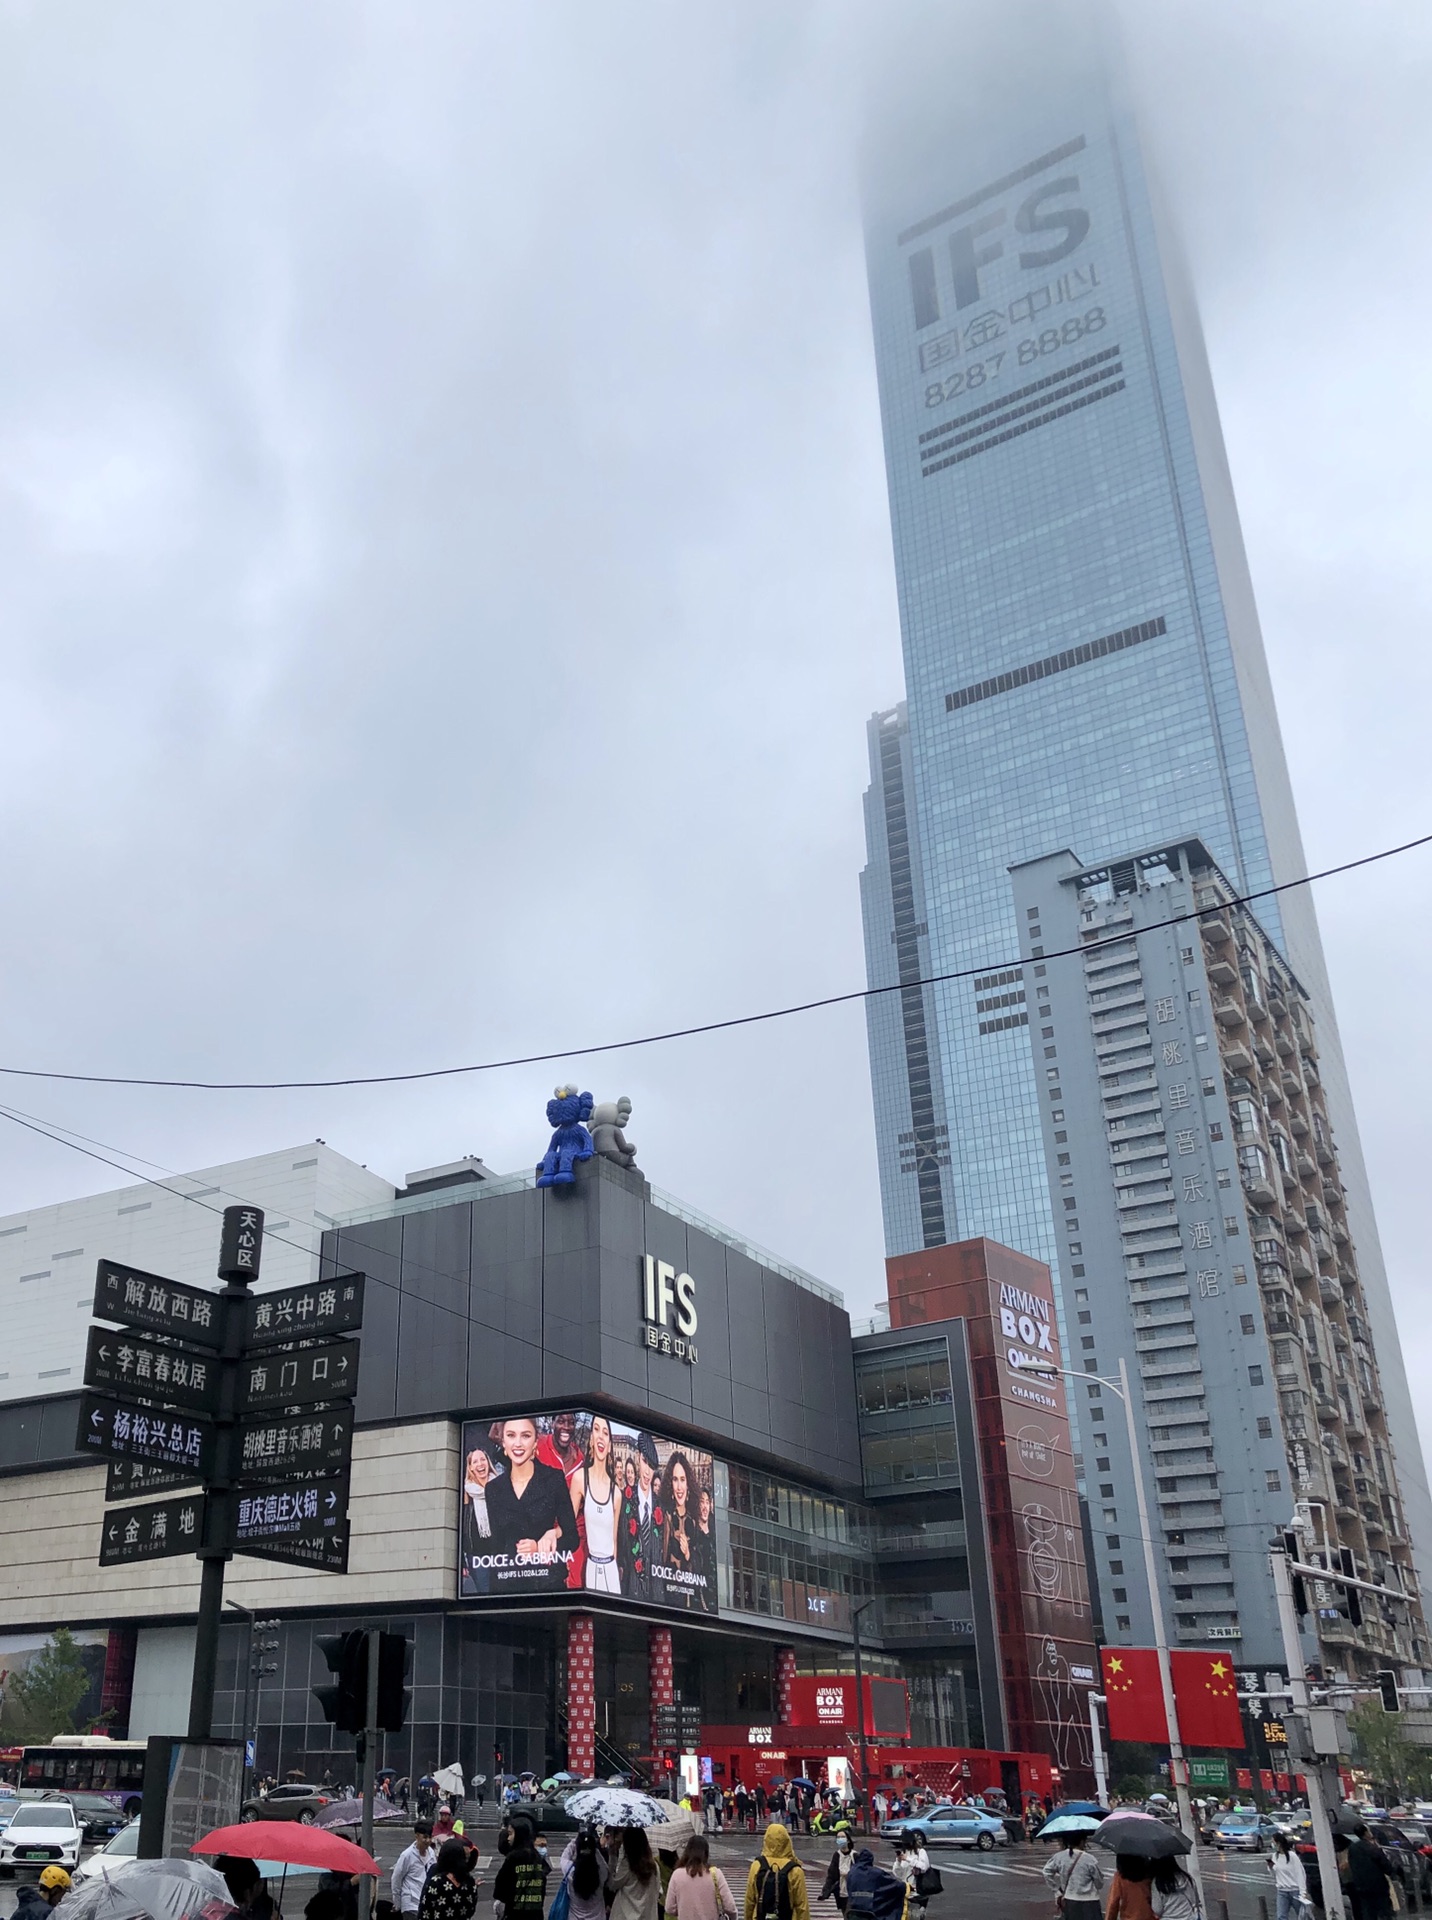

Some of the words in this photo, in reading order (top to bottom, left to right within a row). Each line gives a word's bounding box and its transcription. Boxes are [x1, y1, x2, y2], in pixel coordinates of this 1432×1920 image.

[908, 175, 1091, 331] IFS
[918, 263, 1101, 374] 国金中心
[924, 350, 1007, 408] 8287
[1017, 306, 1107, 366] 8888
[1154, 997, 1220, 1299] 胡桃里音乐酒馆
[237, 1211, 256, 1267] 天心区
[107, 1273, 119, 1290] 西
[124, 1277, 212, 1328] 解放西路
[255, 1288, 337, 1330] 黄兴中路
[343, 1286, 355, 1301] 南
[645, 1253, 698, 1337] IFS
[1000, 1281, 1050, 1323] ARMANI
[647, 1325, 699, 1365] 国金中心
[1000, 1307, 1053, 1353] BOX
[116, 1344, 207, 1391] 李富春故居
[250, 1357, 328, 1393] 南门口
[1011, 1385, 1058, 1408] CHANGSHA
[113, 1409, 202, 1457] 杨裕兴总店
[242, 1422, 324, 1459] 胡桃里音乐酒馆
[124, 1507, 195, 1544] 金满地
[238, 1489, 318, 1527] 重庆德庄火锅
[472, 1554, 508, 1569] DOLCE
[515, 1550, 575, 1566] GABBANA
[651, 1564, 673, 1580] DOLCE
[676, 1570, 707, 1588] GABBANA
[816, 1687, 843, 1696] ARMANI
[816, 1695, 844, 1706] BOX
[748, 1734, 772, 1743] BOX
[749, 1726, 772, 1735] ARMANI
[761, 1751, 773, 1759] ON
[773, 1751, 786, 1759] AIR
